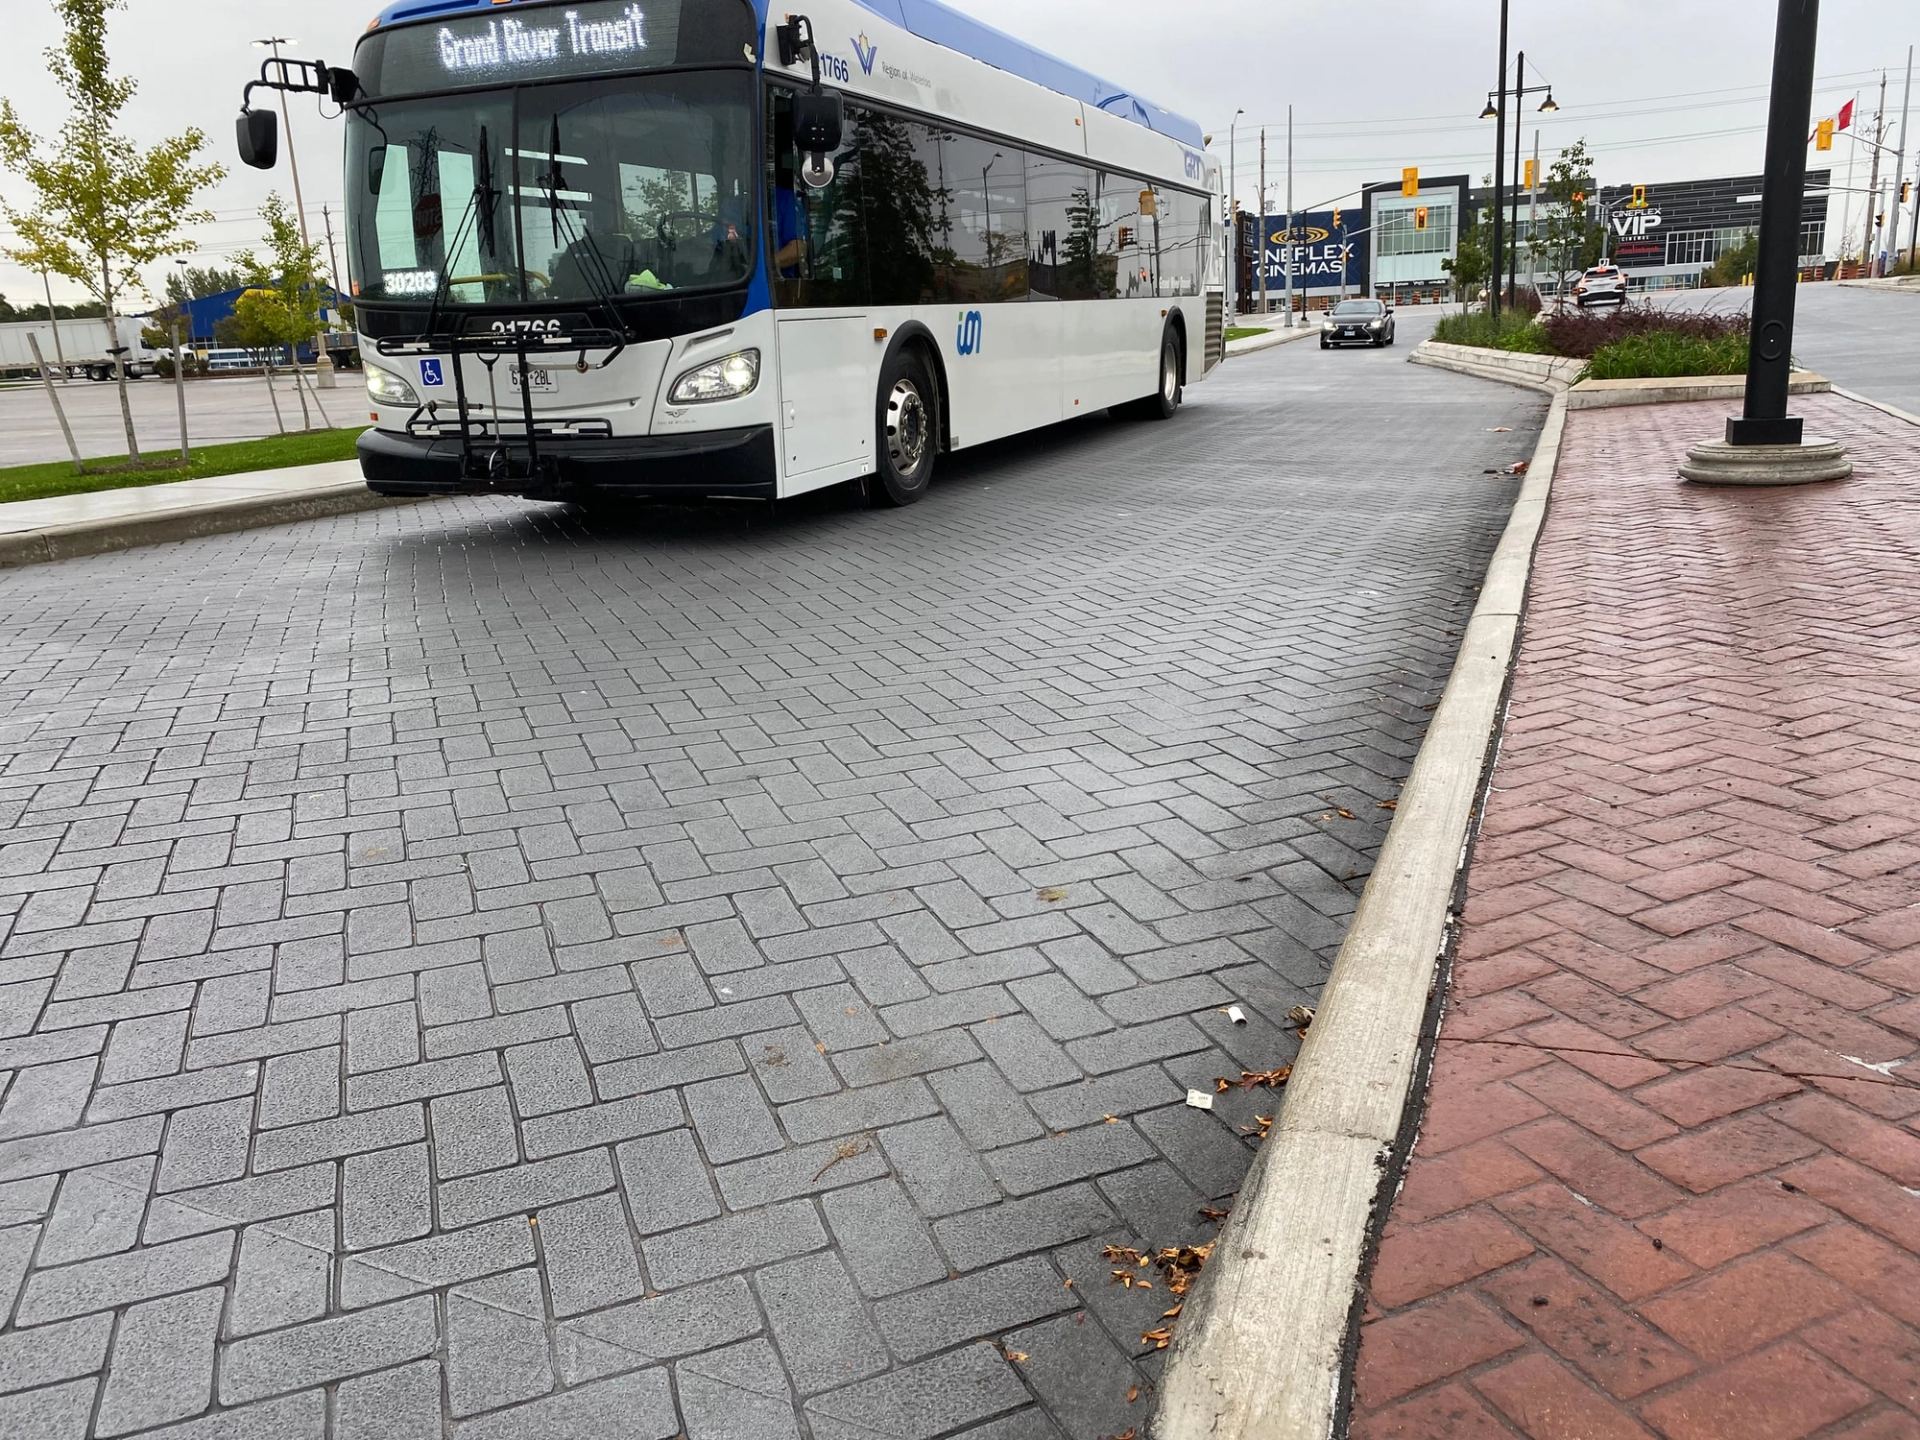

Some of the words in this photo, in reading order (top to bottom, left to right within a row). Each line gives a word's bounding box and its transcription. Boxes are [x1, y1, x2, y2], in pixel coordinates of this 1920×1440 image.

[438, 20, 500, 69] Grand
[502, 17, 559, 62] River
[565, 3, 647, 54] Transit
[817, 53, 849, 83] 1766
[881, 61, 902, 79] Region
[1184, 150, 1201, 181] GRT
[1612, 207, 1662, 218] CINEPLEX
[1612, 214, 1662, 236] VIP
[1256, 261, 1343, 278] CINEMAS
[383, 270, 438, 296] 30203
